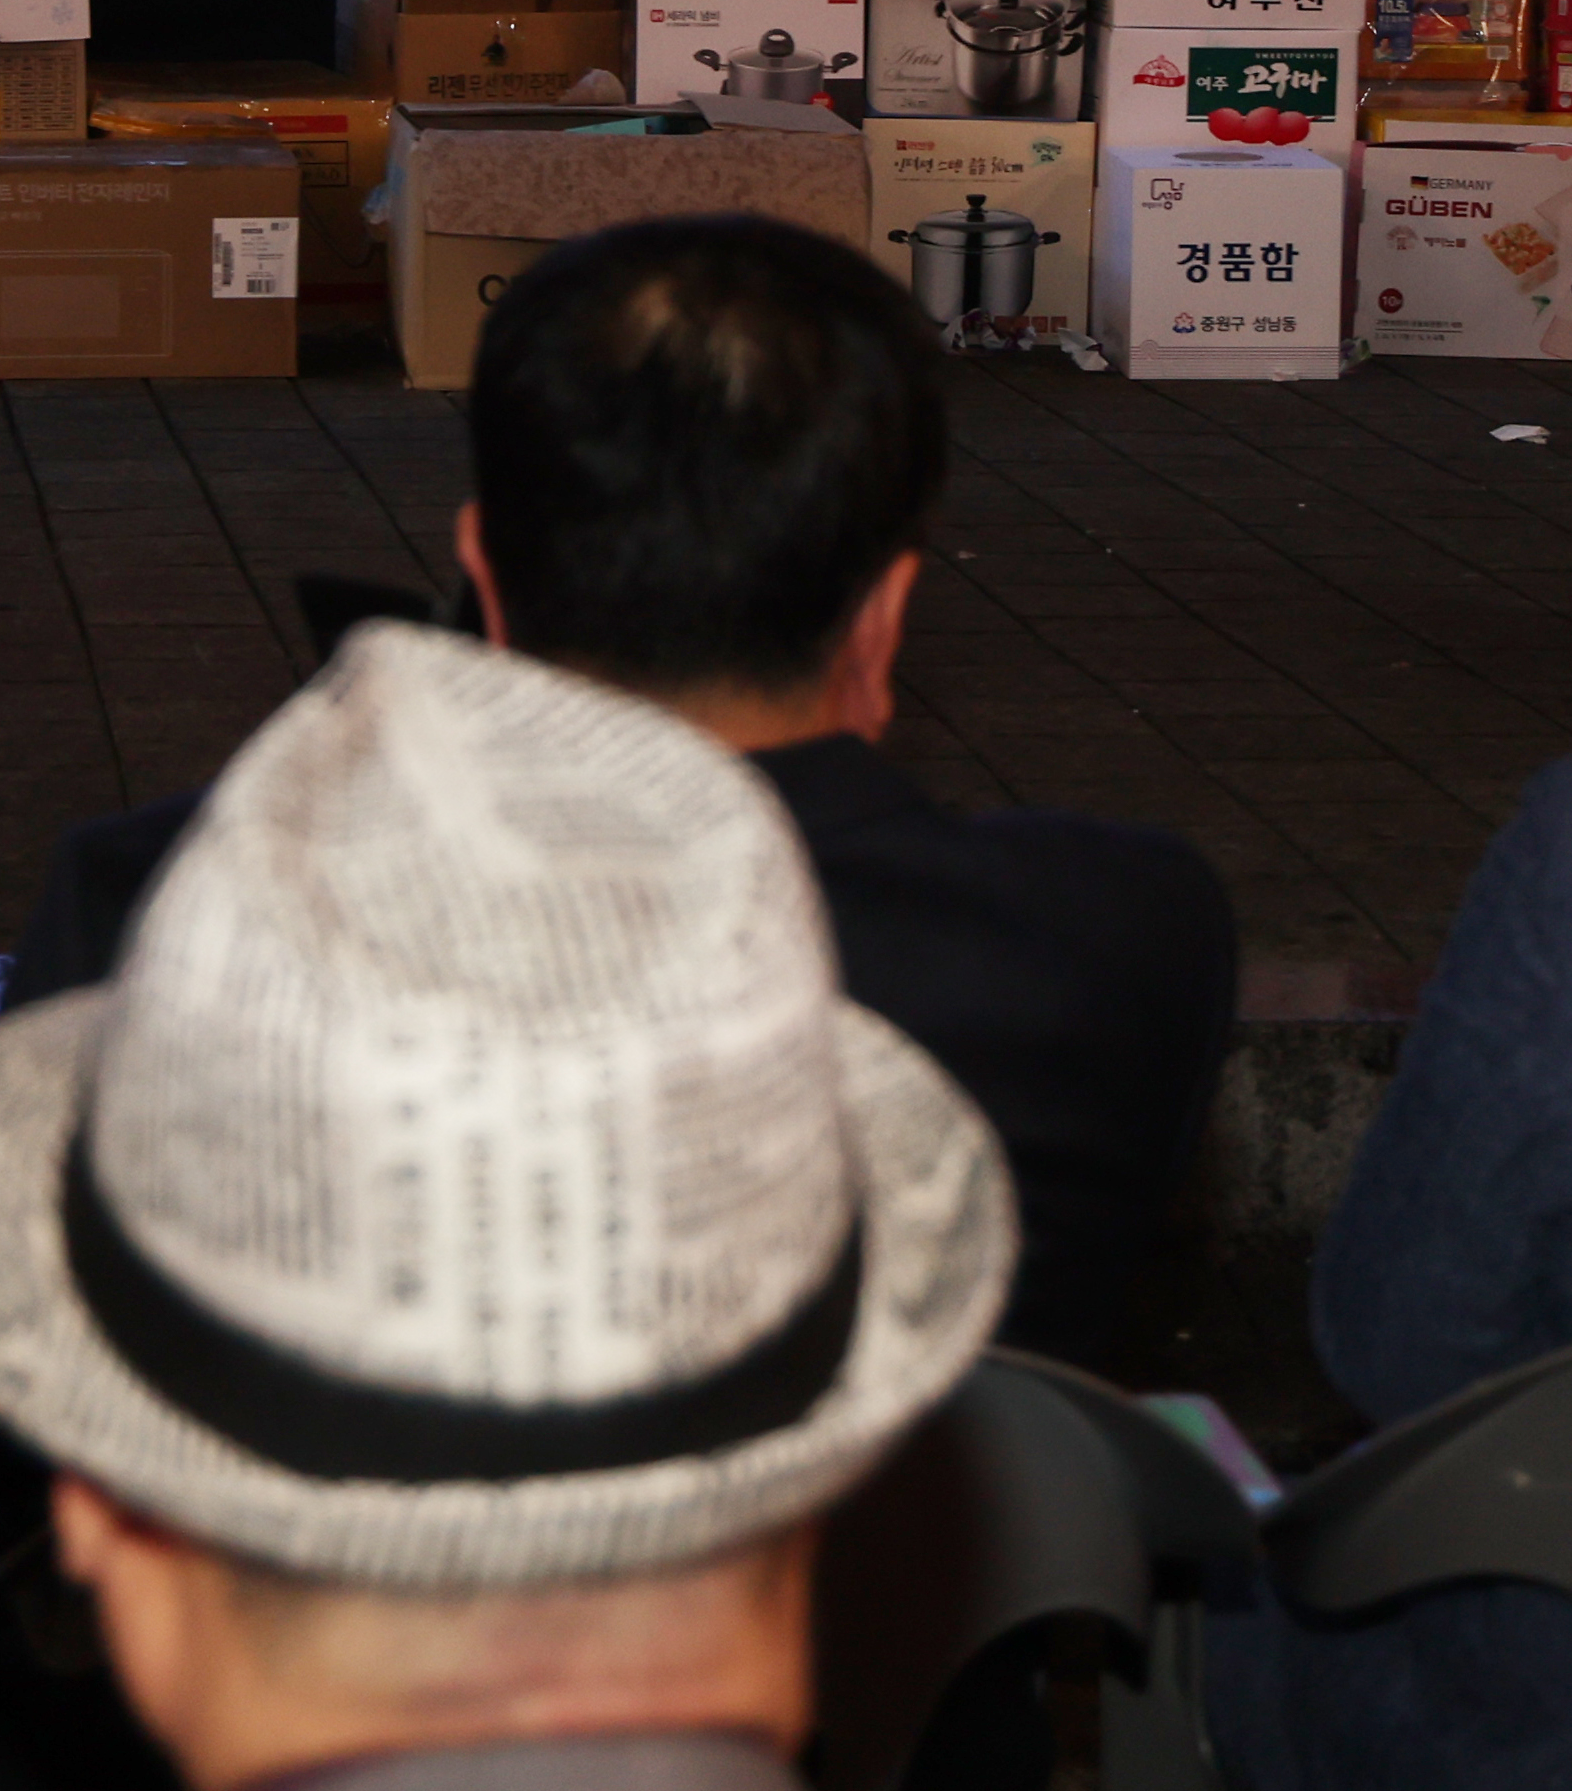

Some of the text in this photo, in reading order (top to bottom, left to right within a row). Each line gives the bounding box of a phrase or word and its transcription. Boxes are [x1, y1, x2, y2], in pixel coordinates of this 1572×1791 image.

[1195, 75, 1229, 92] 여주
[1237, 62, 1327, 99] 고구마
[1429, 177, 1495, 192] GERMANY
[1384, 195, 1494, 220] GÜBEN
[1177, 242, 1300, 284] 경품함
[1200, 314, 1298, 333] 중원구 성남동
